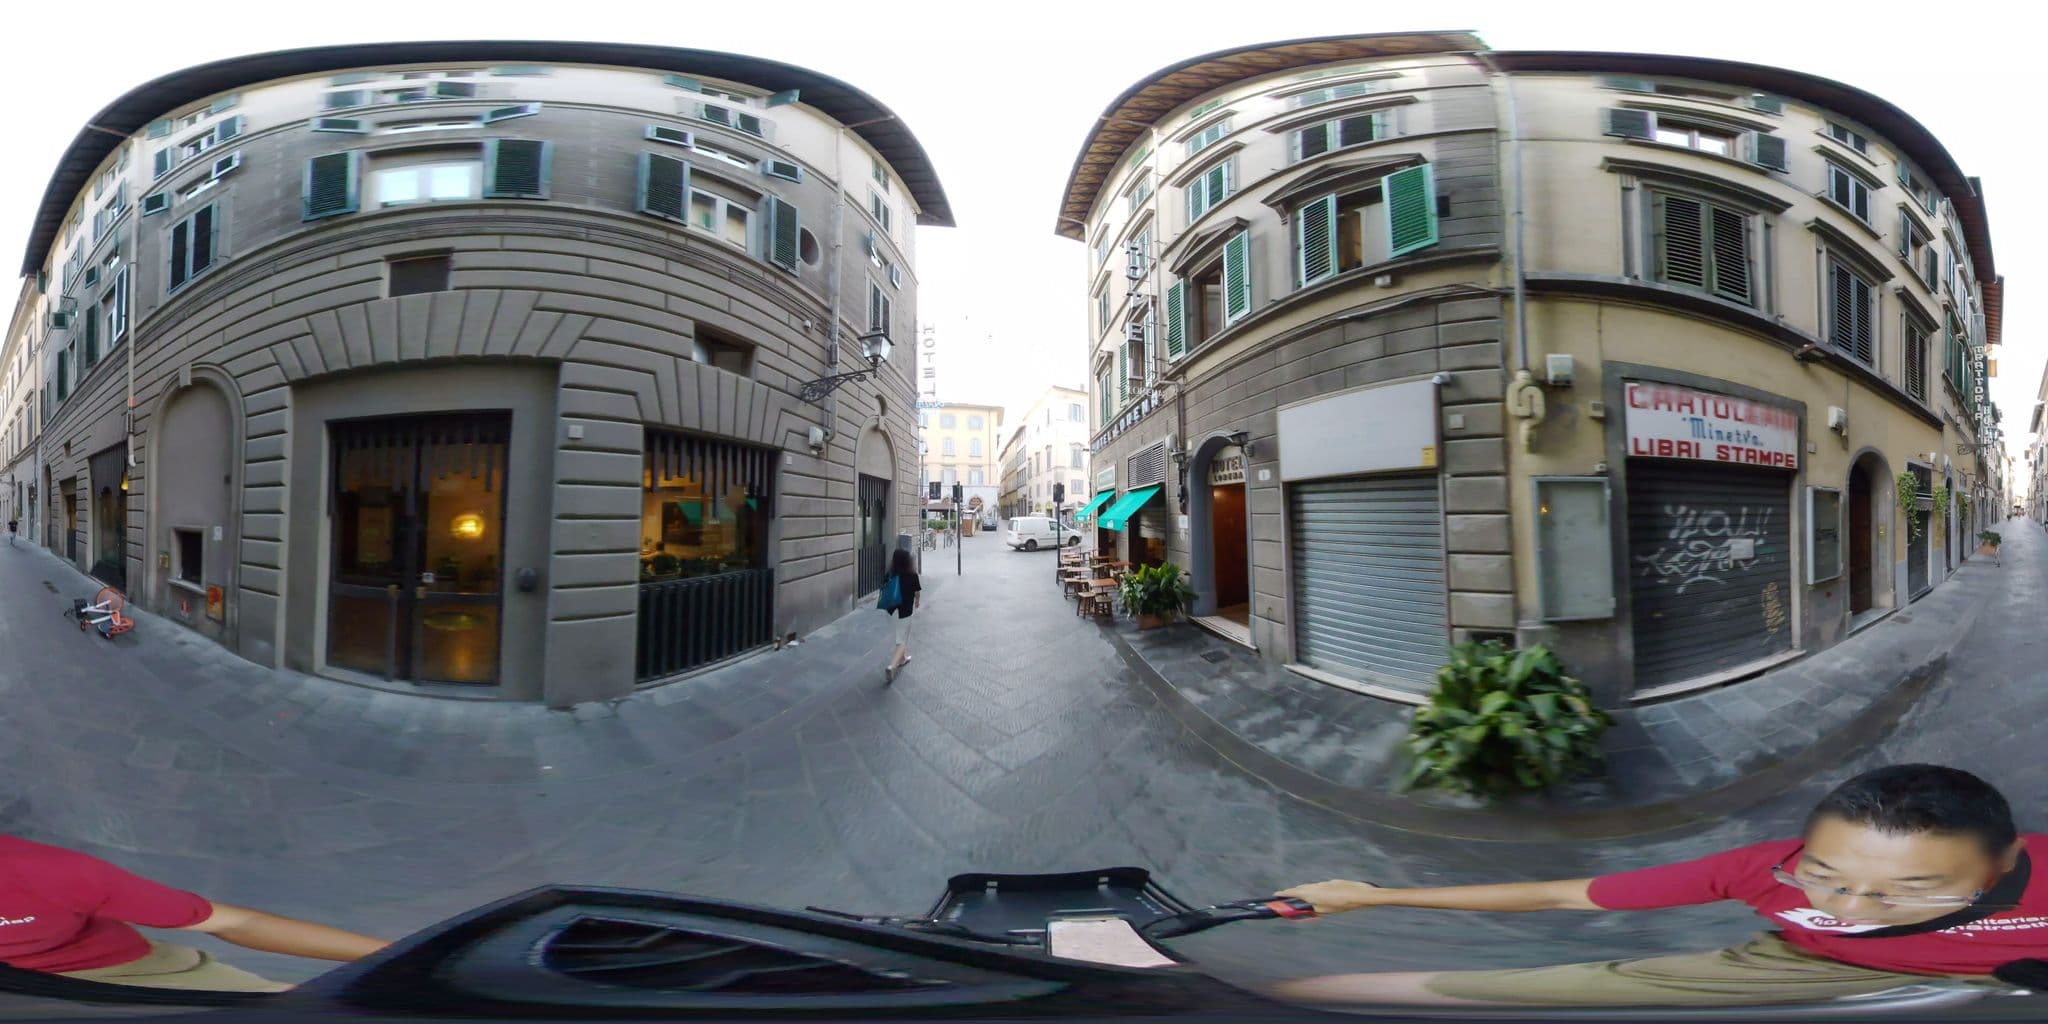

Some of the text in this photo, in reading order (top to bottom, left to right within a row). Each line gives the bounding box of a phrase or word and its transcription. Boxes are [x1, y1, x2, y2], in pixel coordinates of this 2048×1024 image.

[1125, 238, 1143, 380] HOTEL
[1975, 346, 1983, 421] TRATTORIA
[1211, 455, 1243, 474] HOTEL
[1634, 437, 1795, 468] LIBRI STAMPE
